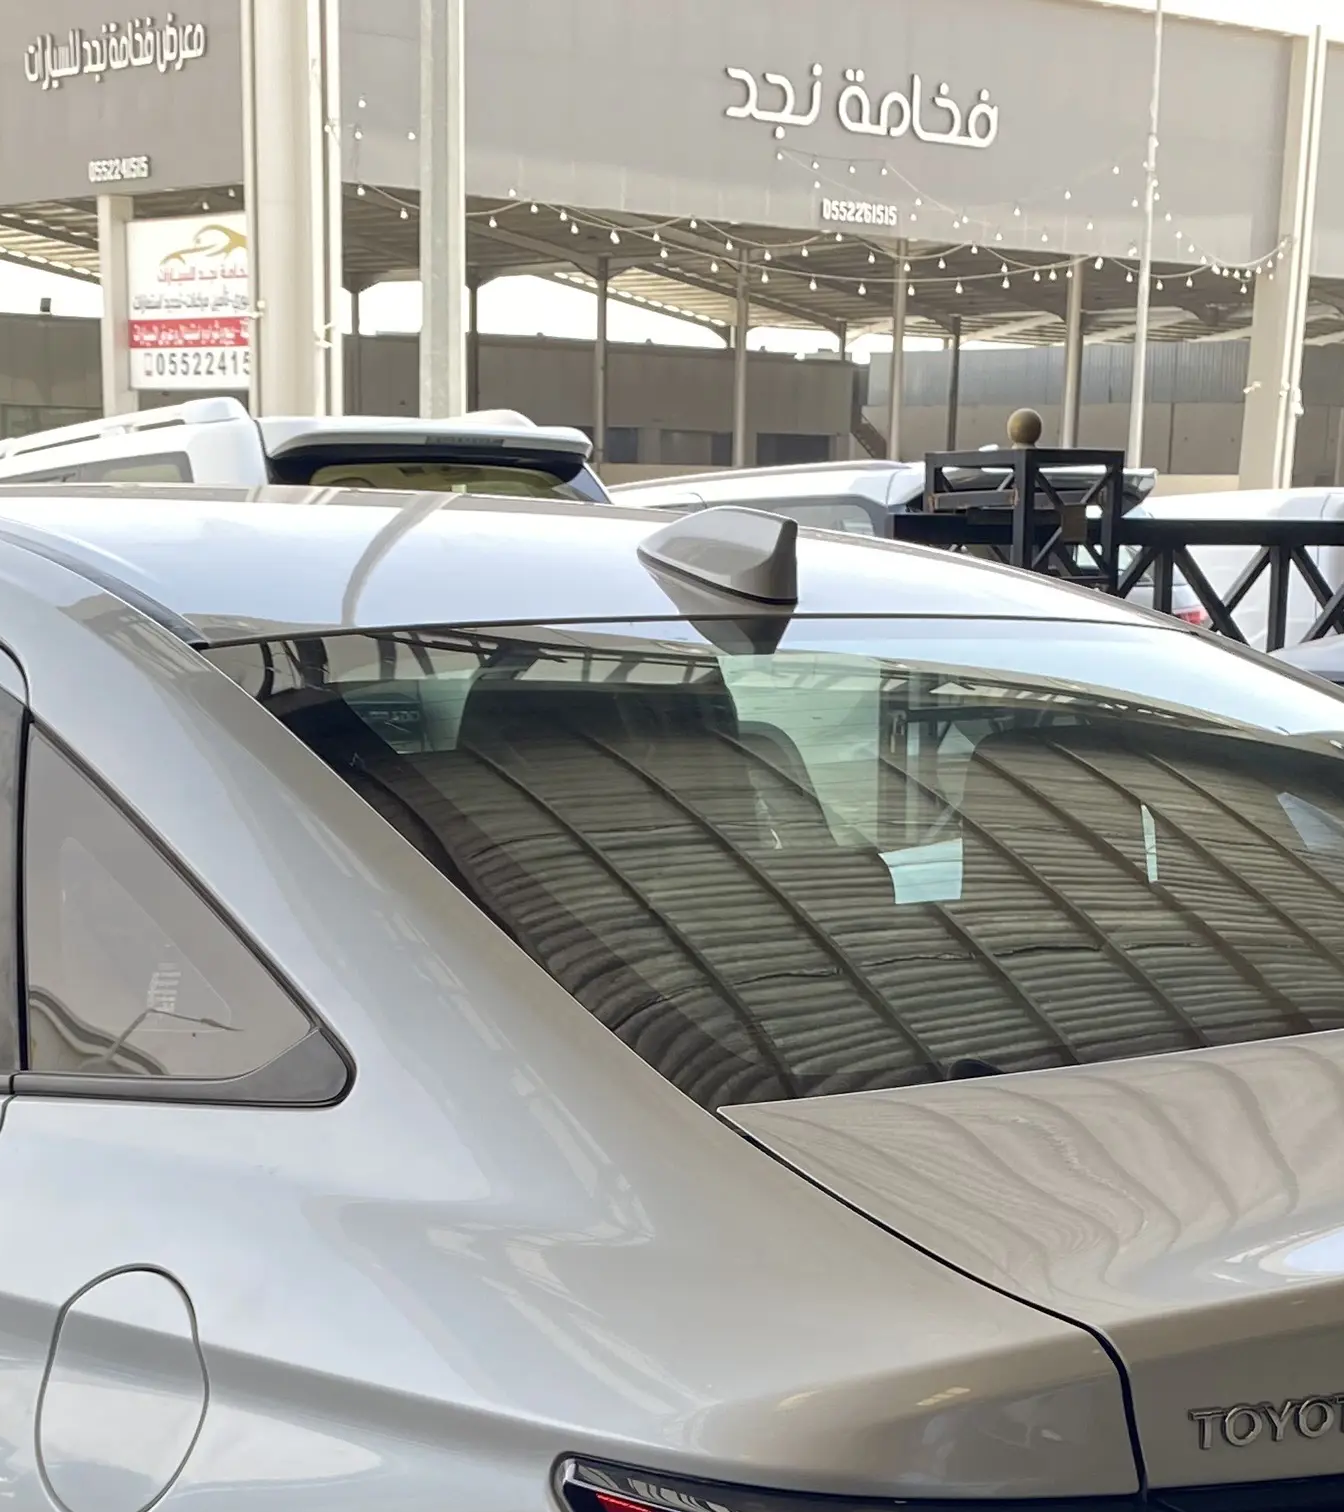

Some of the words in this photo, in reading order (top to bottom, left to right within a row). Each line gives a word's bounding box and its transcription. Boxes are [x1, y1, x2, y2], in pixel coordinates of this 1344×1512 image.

[24, 28, 82, 91] للسيارات
[82, 22, 108, 83] نجد
[108, 16, 155, 70] فخامة
[156, 12, 206, 73] معرض
[725, 62, 823, 140] نجد
[837, 68, 999, 149] فخامة
